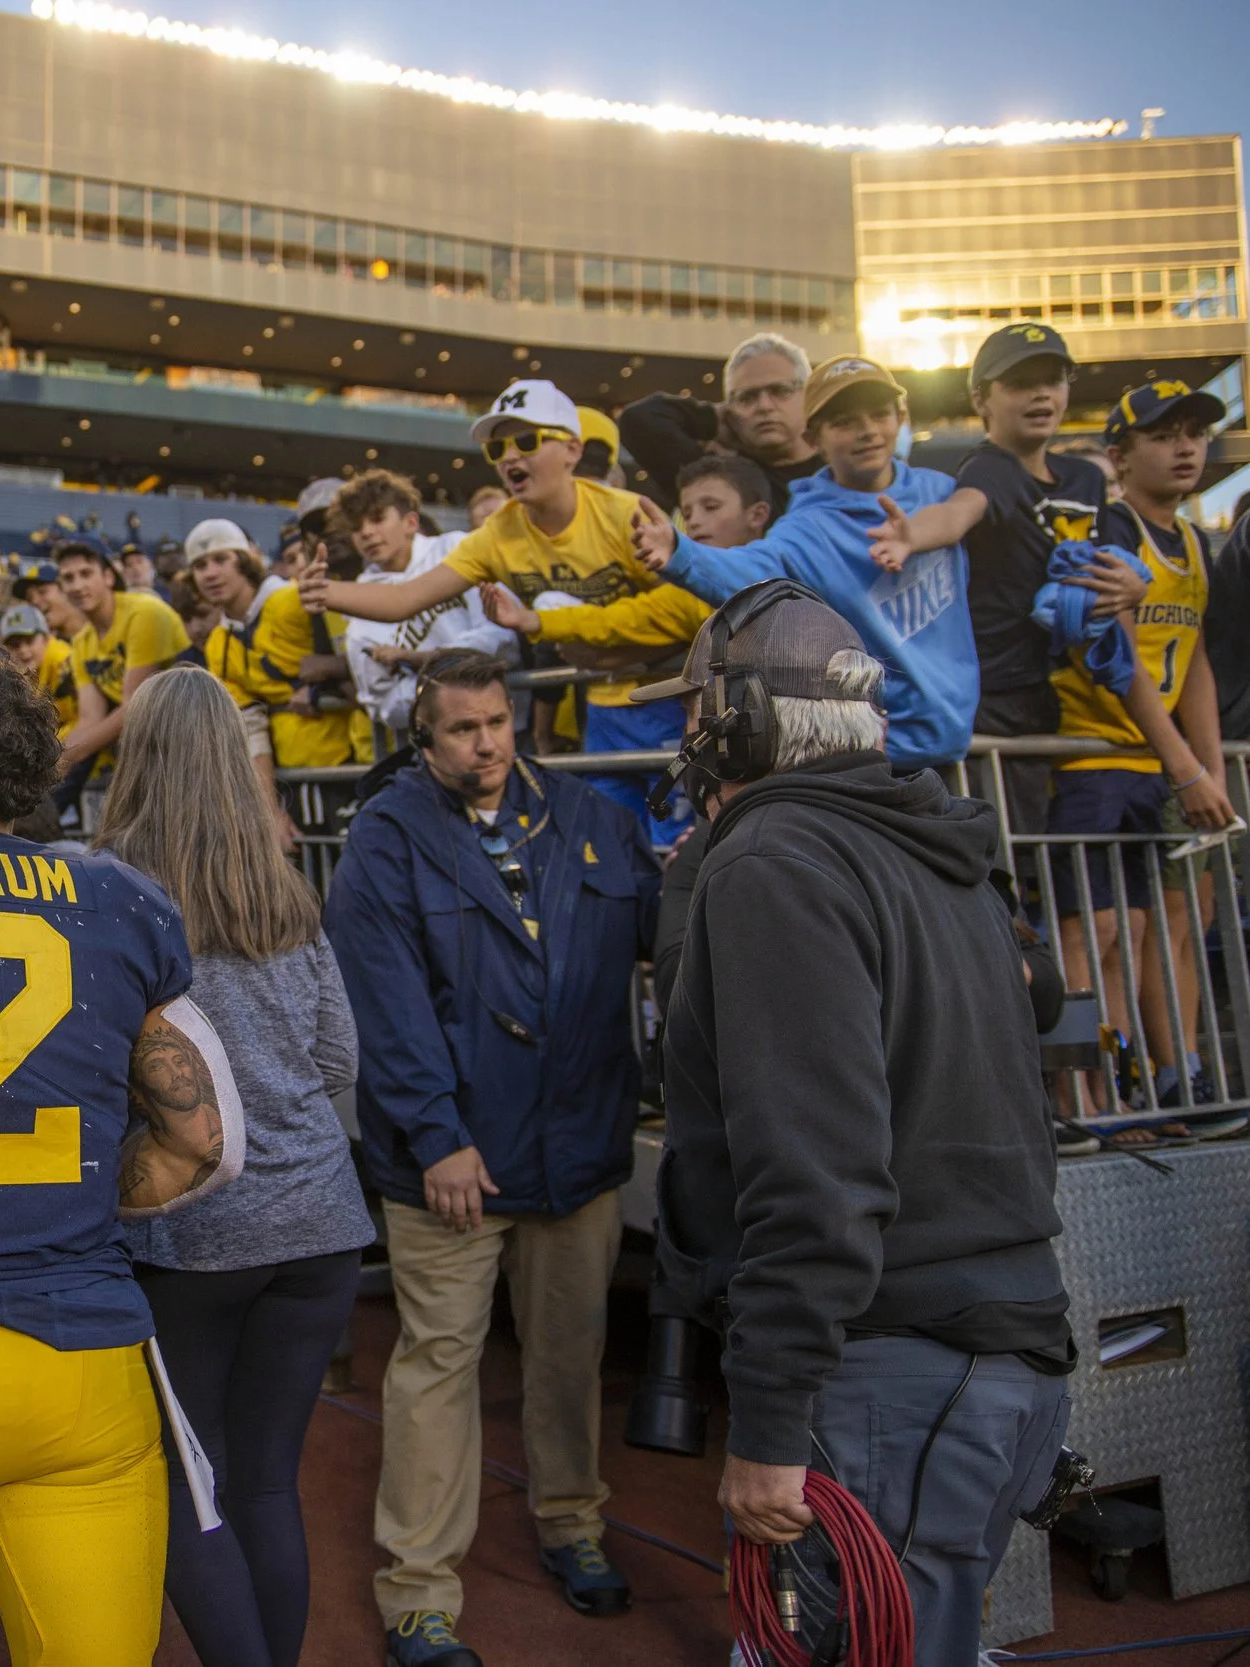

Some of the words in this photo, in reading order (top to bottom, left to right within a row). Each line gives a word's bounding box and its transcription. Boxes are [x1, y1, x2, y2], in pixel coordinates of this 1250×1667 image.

[499, 389, 529, 412] M
[875, 560, 955, 641] NIKE
[1159, 636, 1180, 694] 1
